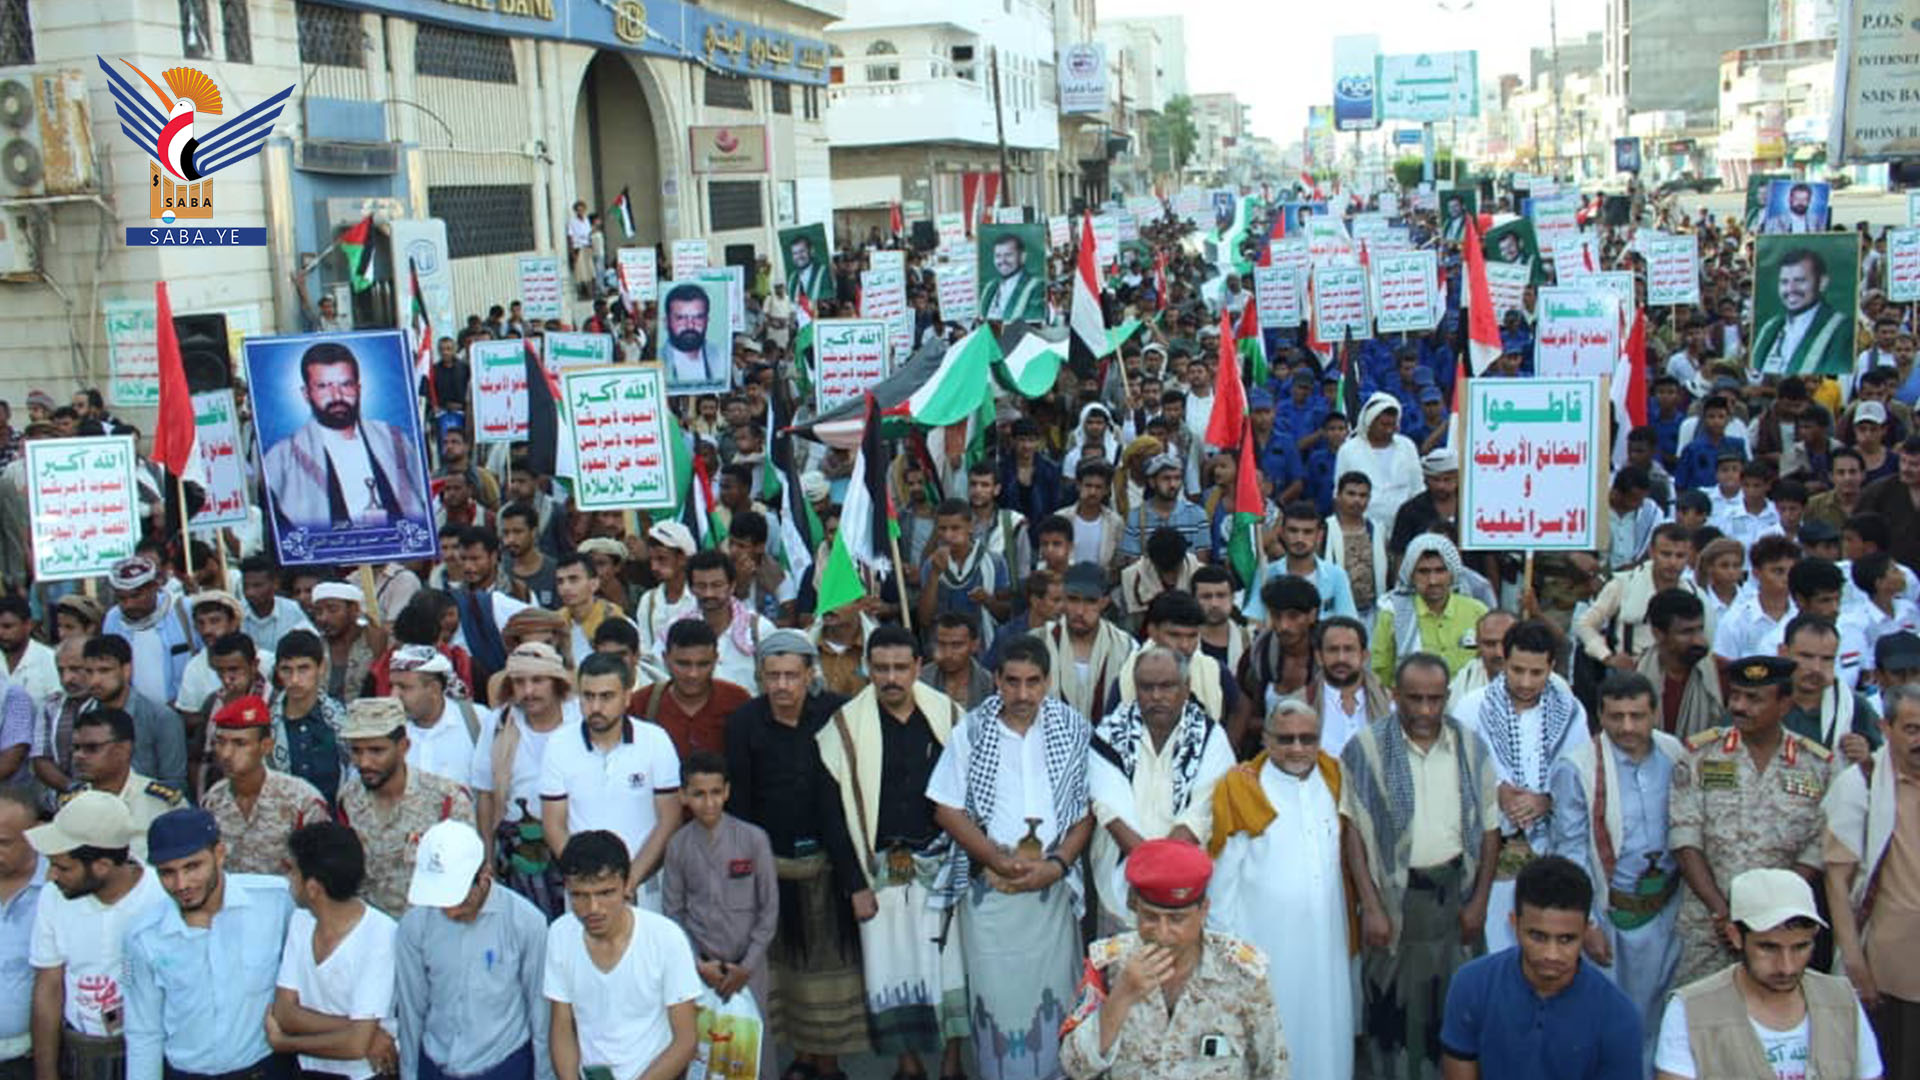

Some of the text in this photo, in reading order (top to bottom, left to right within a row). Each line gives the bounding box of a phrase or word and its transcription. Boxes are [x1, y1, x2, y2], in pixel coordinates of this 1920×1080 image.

[1862, 13, 1904, 29] P.O.S
[624, 380, 654, 399] الله
[1482, 390, 1582, 431] قاطعوا
[92, 448, 124, 469] الله
[1536, 439, 1588, 471] البضائع
[1523, 472, 1533, 498] و
